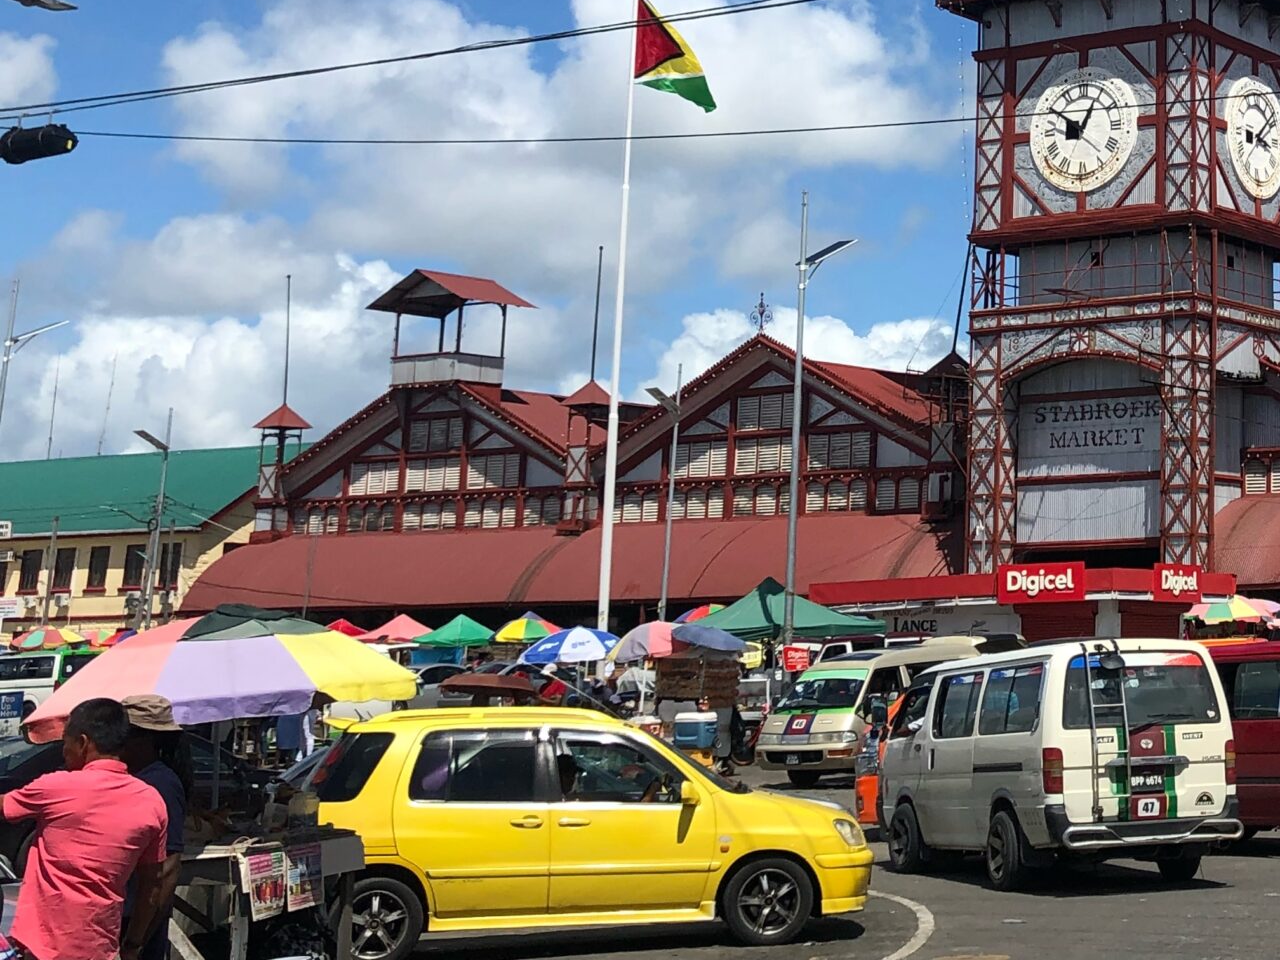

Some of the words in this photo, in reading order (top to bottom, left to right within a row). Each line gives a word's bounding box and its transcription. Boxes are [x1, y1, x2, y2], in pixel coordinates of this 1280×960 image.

[1034, 400, 1160, 424] STABROEK
[1049, 427, 1145, 449] MARKET
[1006, 568, 1075, 596] Digicel
[1161, 569, 1198, 595] Digicel
[1131, 776, 1145, 787] BPP
[1142, 802, 1155, 813] 47
